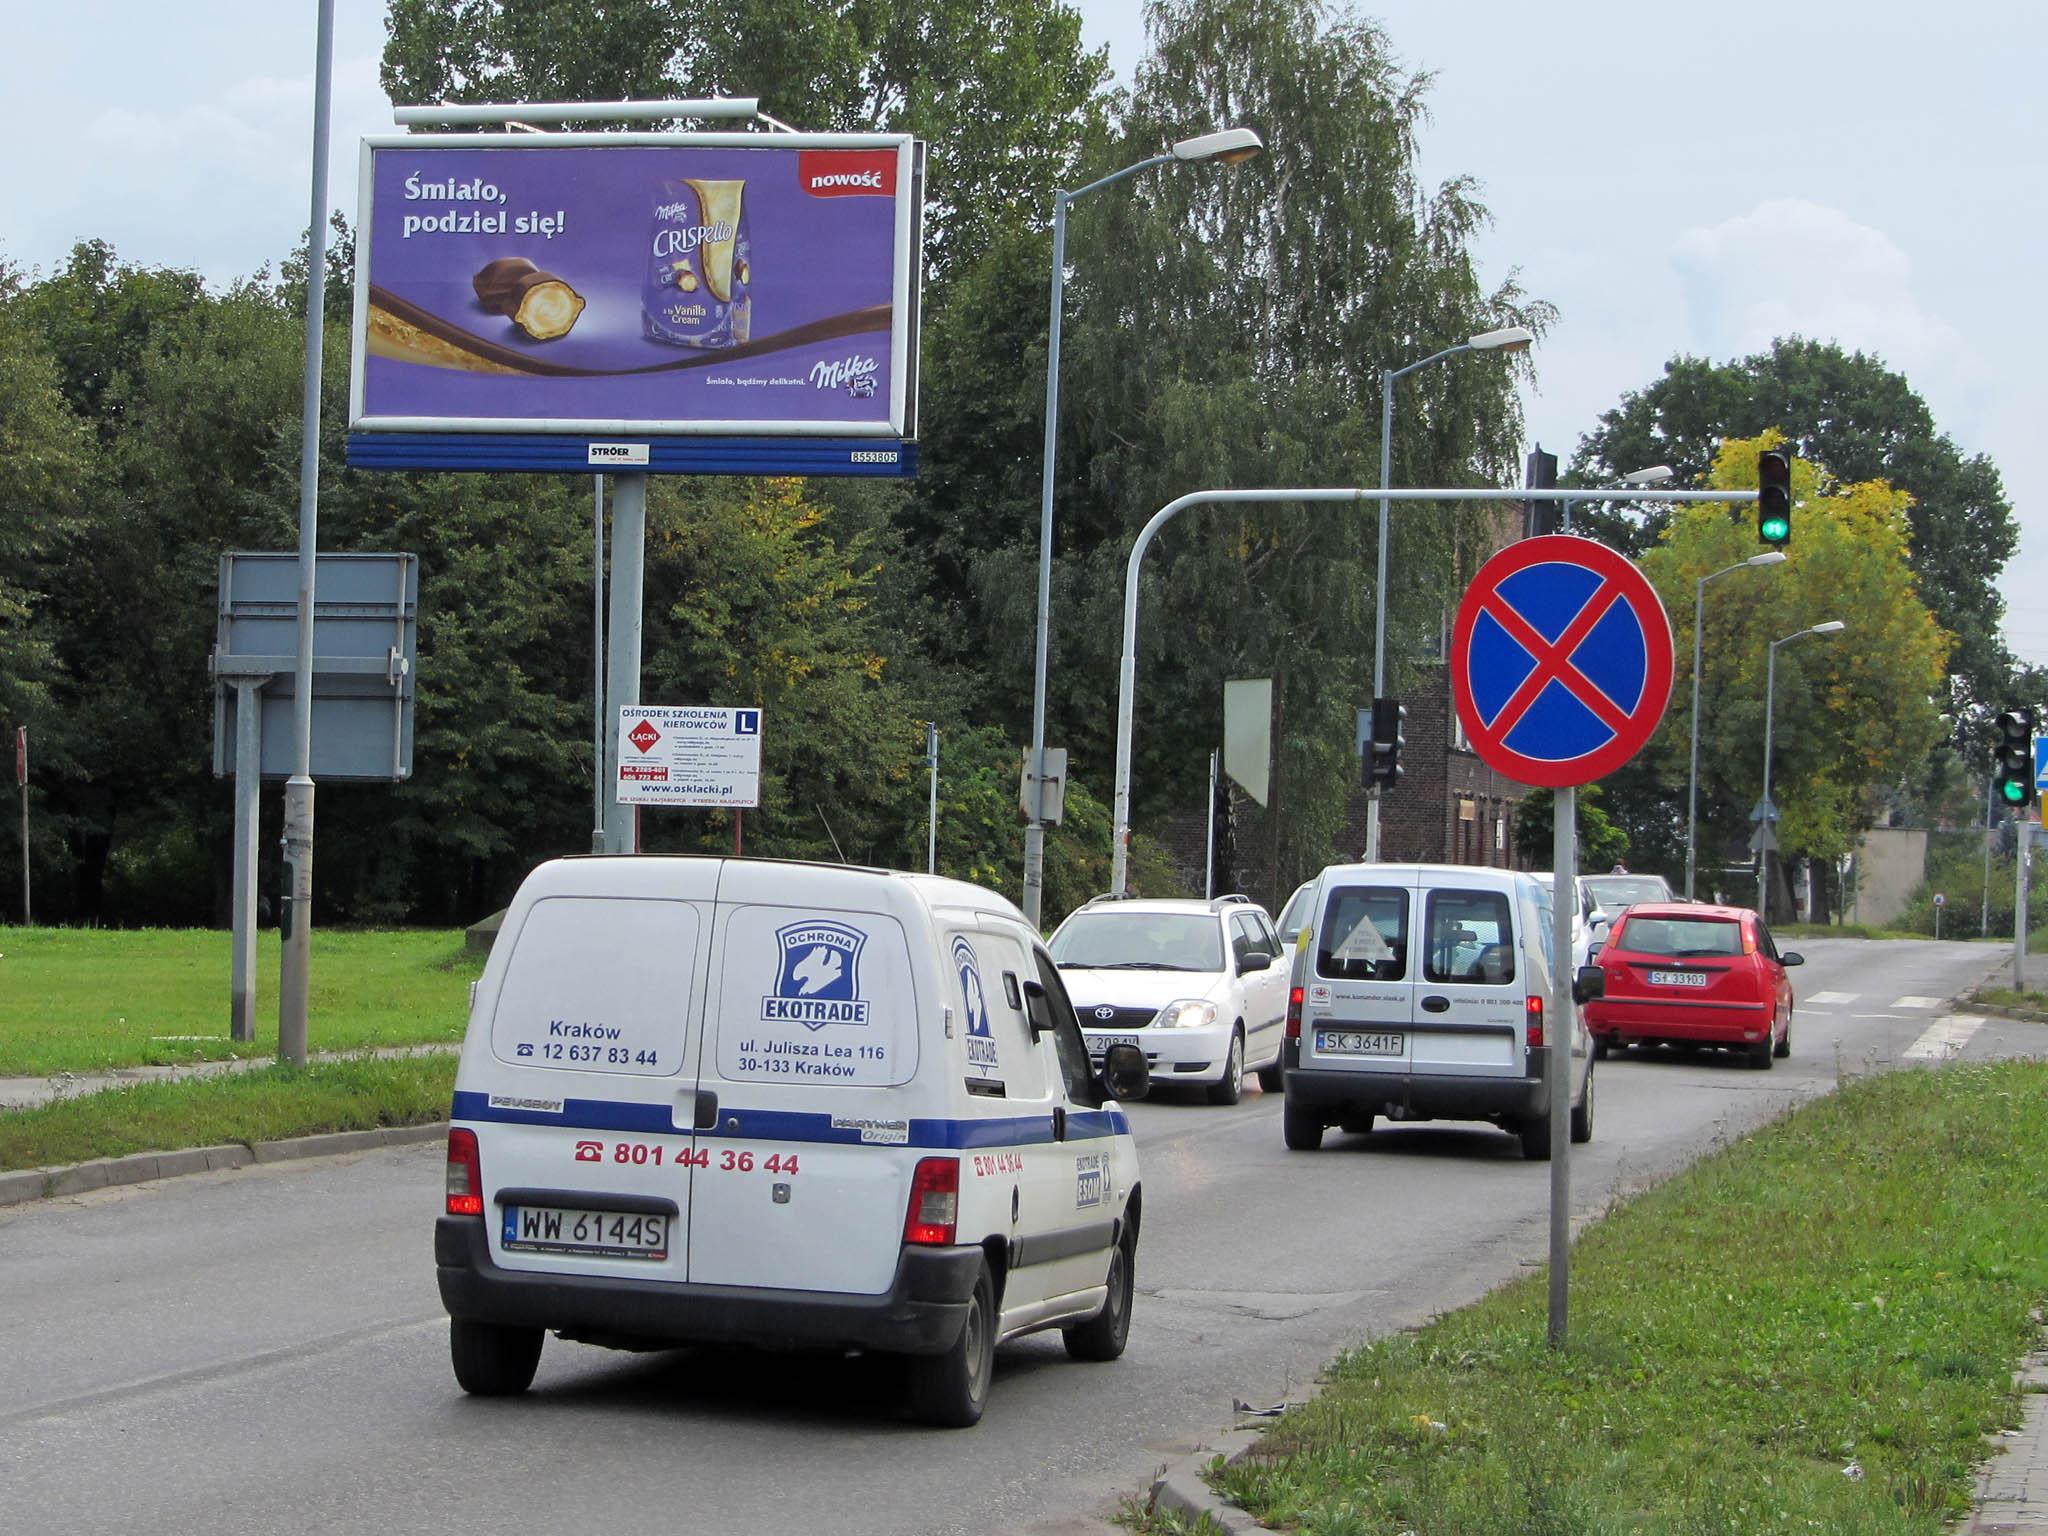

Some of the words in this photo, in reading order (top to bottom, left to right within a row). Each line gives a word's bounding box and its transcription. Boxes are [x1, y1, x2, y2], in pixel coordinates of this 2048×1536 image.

[404, 171, 507, 204] Śmiało,
[811, 170, 882, 188] nowość
[403, 210, 507, 238] podziel
[515, 211, 565, 239] się!
[671, 314, 701, 325] Cream
[675, 304, 706, 317] Vanilla
[810, 355, 879, 389] Milka
[852, 452, 897, 462] 8553805
[622, 708, 670, 718] OŚRODEK
[672, 709, 728, 719] SZKOLENIA
[740, 713, 754, 732] L
[663, 720, 728, 729] KIEROWCÓW
[631, 733, 657, 742] ŁĄCKI
[641, 784, 733, 796] www.osklacki.pl
[788, 932, 851, 948] OCHRONA
[1672, 973, 1705, 985] 33103
[766, 1000, 865, 1022] EKOTRADE
[550, 1020, 621, 1040] Kraków
[740, 1039, 758, 1053] ul.
[764, 1040, 819, 1056] Julisza
[825, 1044, 852, 1058] Lea
[859, 1046, 884, 1060] 116
[1327, 1033, 1348, 1049] SK
[1353, 1034, 1401, 1051] 3641F
[543, 1043, 563, 1059] 12
[569, 1045, 601, 1061] 637
[608, 1048, 629, 1064] 83
[636, 1050, 657, 1066] 44
[967, 1039, 997, 1064] EKOTRADE
[738, 1057, 790, 1073] 30-133
[795, 1061, 855, 1077] Kraków
[491, 1095, 563, 1111] PEUGEOT
[833, 1118, 908, 1131] PARTNER
[862, 1130, 908, 1144] Origin
[614, 1143, 663, 1166] 801
[674, 1147, 709, 1168] 44
[720, 1150, 754, 1172] 36
[763, 1153, 799, 1175] 44
[523, 1210, 562, 1239] WW
[573, 1213, 661, 1246] 6144S
